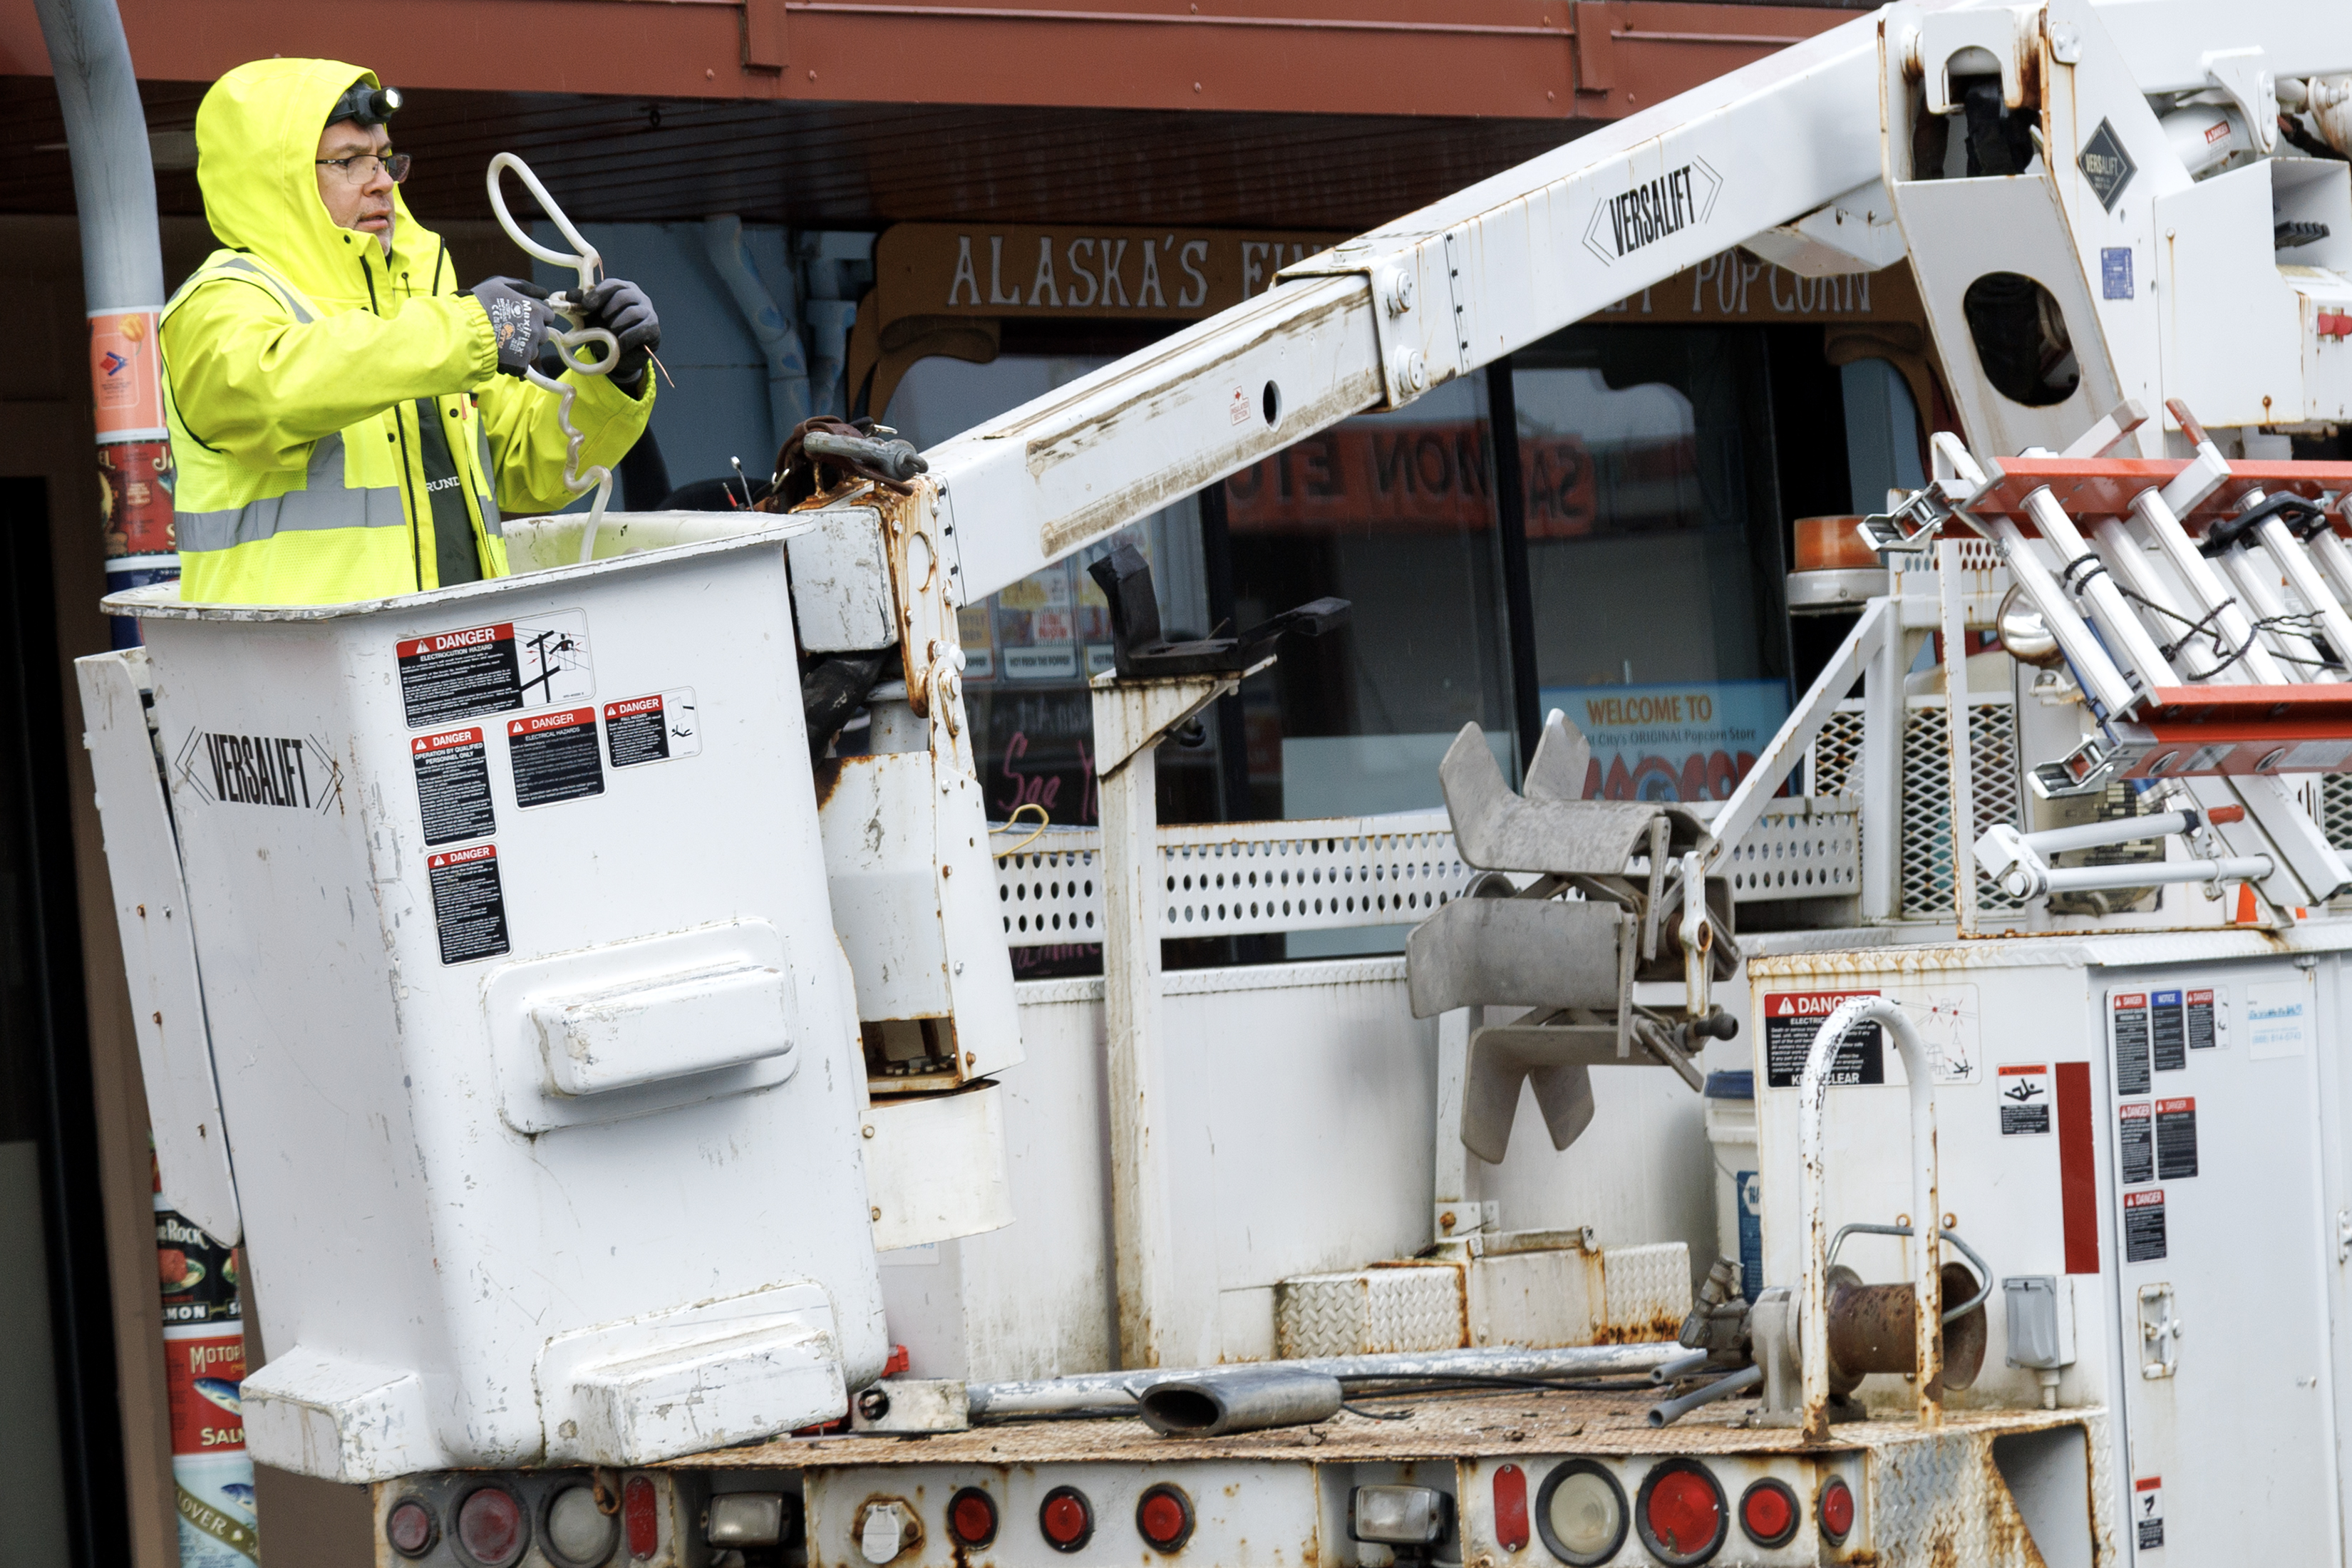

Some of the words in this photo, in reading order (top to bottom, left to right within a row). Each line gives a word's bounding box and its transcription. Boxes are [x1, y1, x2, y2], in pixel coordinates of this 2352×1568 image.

[2085, 153, 2119, 177] VERSALIFT
[1609, 165, 1695, 257] VERSALIFT
[947, 234, 1209, 308] ALASKA'S
[435, 628, 495, 650] DANGER
[420, 649, 468, 662] ELECTROCUTION
[469, 644, 493, 654] HAZARD
[619, 698, 660, 714] DANGER
[1586, 696, 1683, 726] WELCOME
[1684, 694, 1712, 722] TO
[532, 713, 574, 729] DANGER
[433, 731, 472, 746] DANGER
[525, 732, 555, 741] ELECTRICAL
[1630, 730, 1681, 743] ORIGINAL
[1685, 729, 1727, 746] Popcorn
[1729, 727, 1756, 739] Store
[415, 751, 445, 760] OPERATION
[455, 743, 483, 752] QUALIFIED
[425, 754, 458, 765] PERSONNEL
[459, 751, 474, 760] ONLY
[205, 733, 310, 809] VERSALIFT
[998, 731, 1061, 812] See
[450, 847, 490, 862] DANGER
[1797, 996, 1853, 1013] DANG
[2135, 1192, 2162, 1206] DANGER
